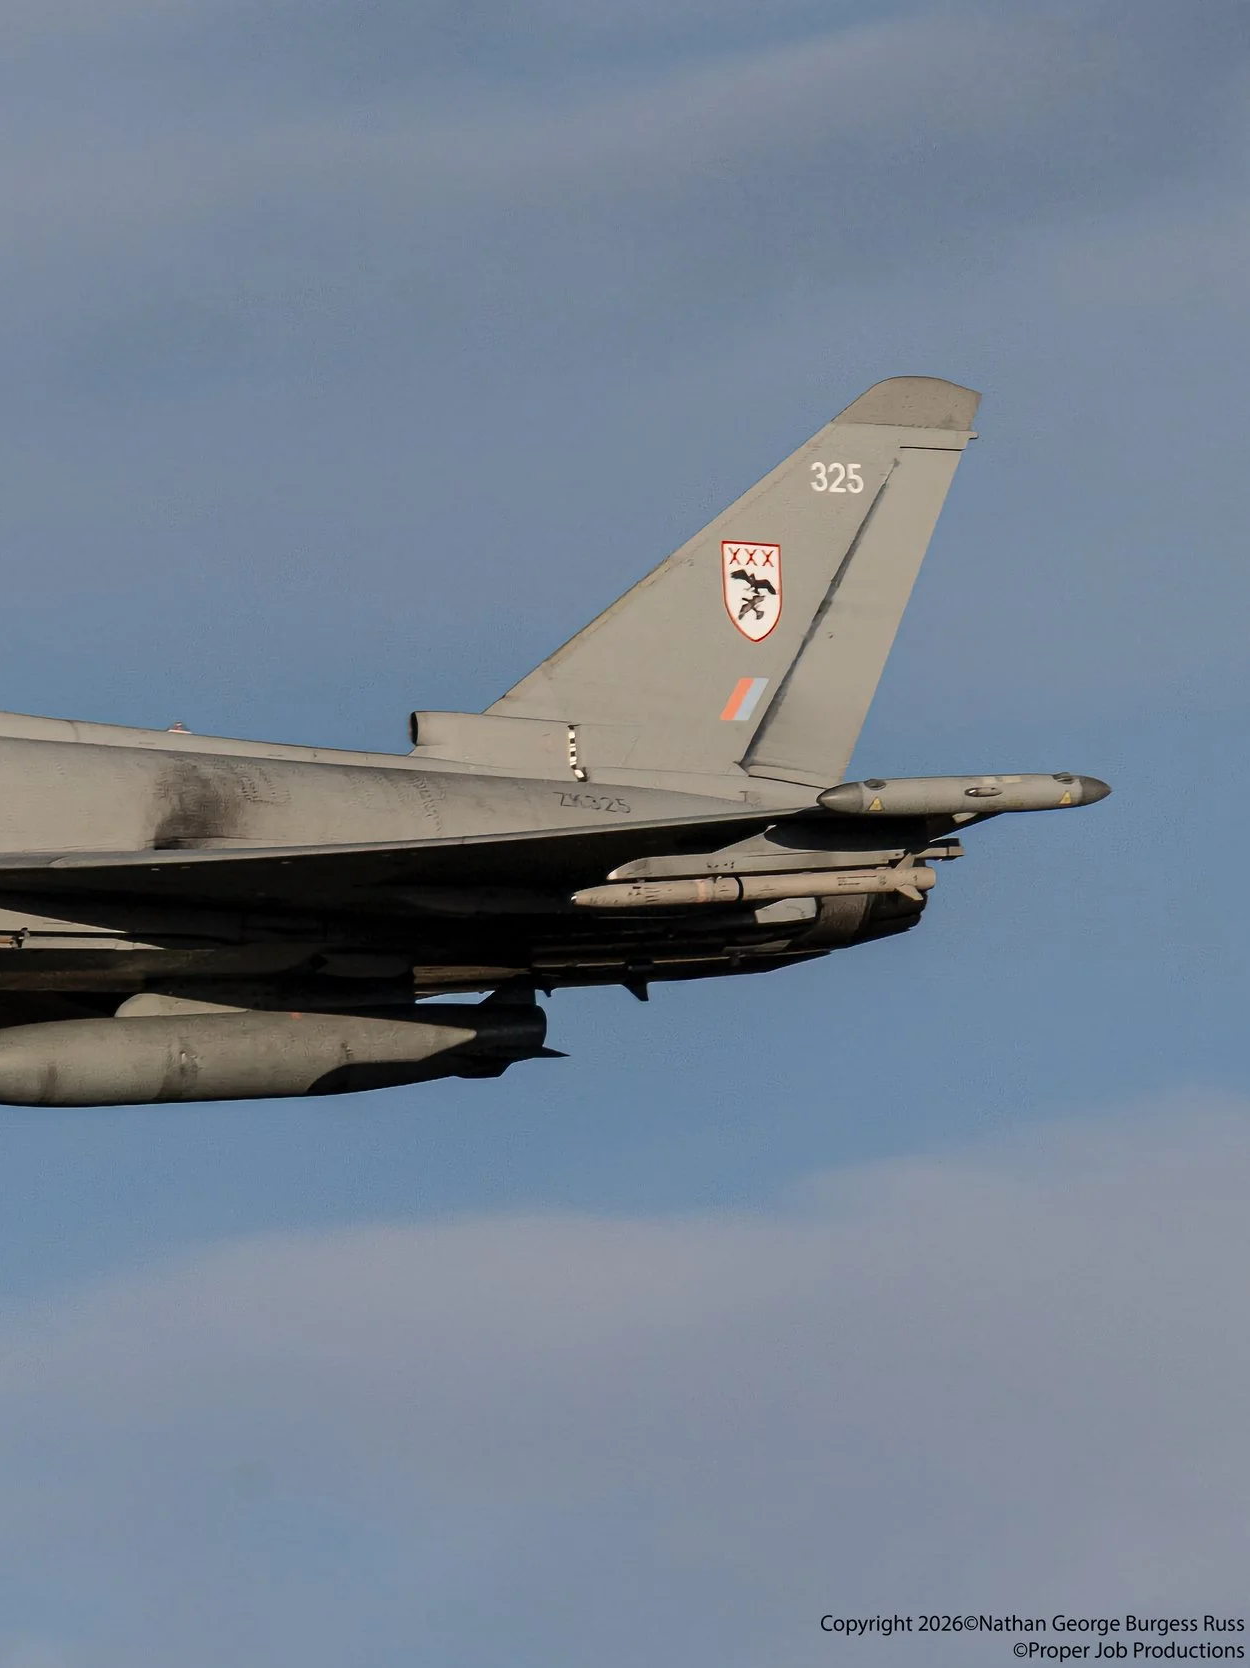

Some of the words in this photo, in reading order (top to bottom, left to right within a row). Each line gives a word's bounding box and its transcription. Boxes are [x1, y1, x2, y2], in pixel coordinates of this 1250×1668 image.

[810, 461, 864, 494] 325
[728, 547, 775, 567] XXX
[552, 791, 631, 814] ZK325
